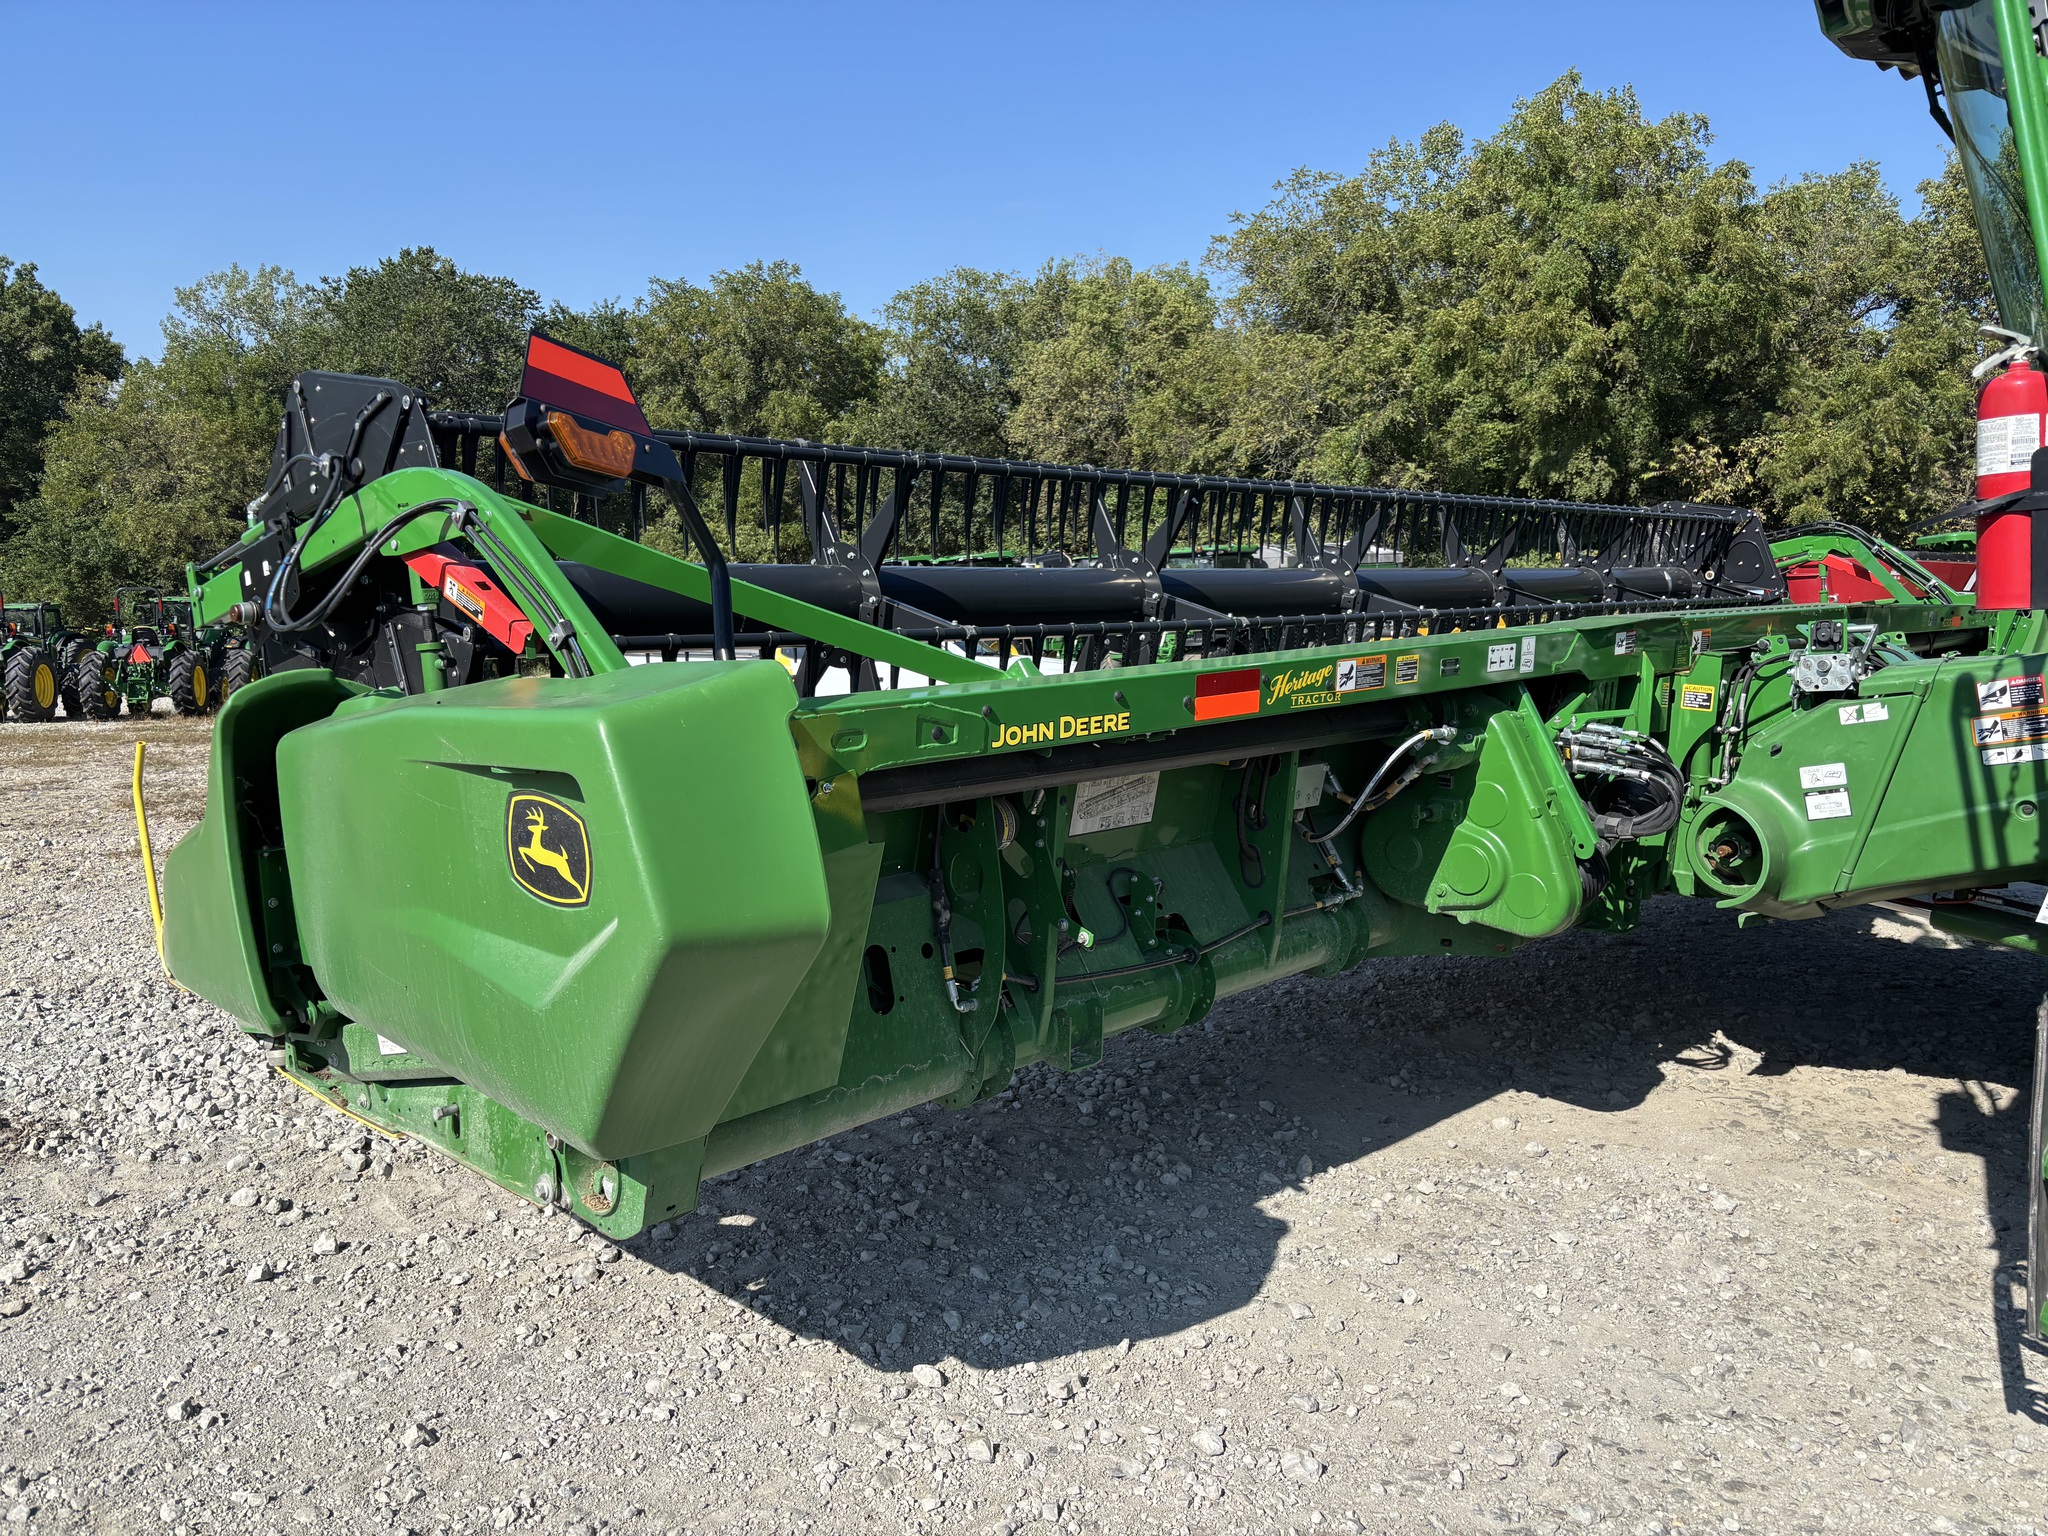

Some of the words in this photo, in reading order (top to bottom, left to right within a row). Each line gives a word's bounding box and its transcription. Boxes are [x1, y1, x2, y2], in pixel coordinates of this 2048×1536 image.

[1267, 664, 1334, 705] Heritage
[2015, 676, 2041, 684] DANGER
[1291, 692, 1342, 706] TRACTOR
[2017, 709, 2046, 717] WARNING
[991, 722, 1055, 749] JOHN
[1059, 711, 1131, 740] DEERE
